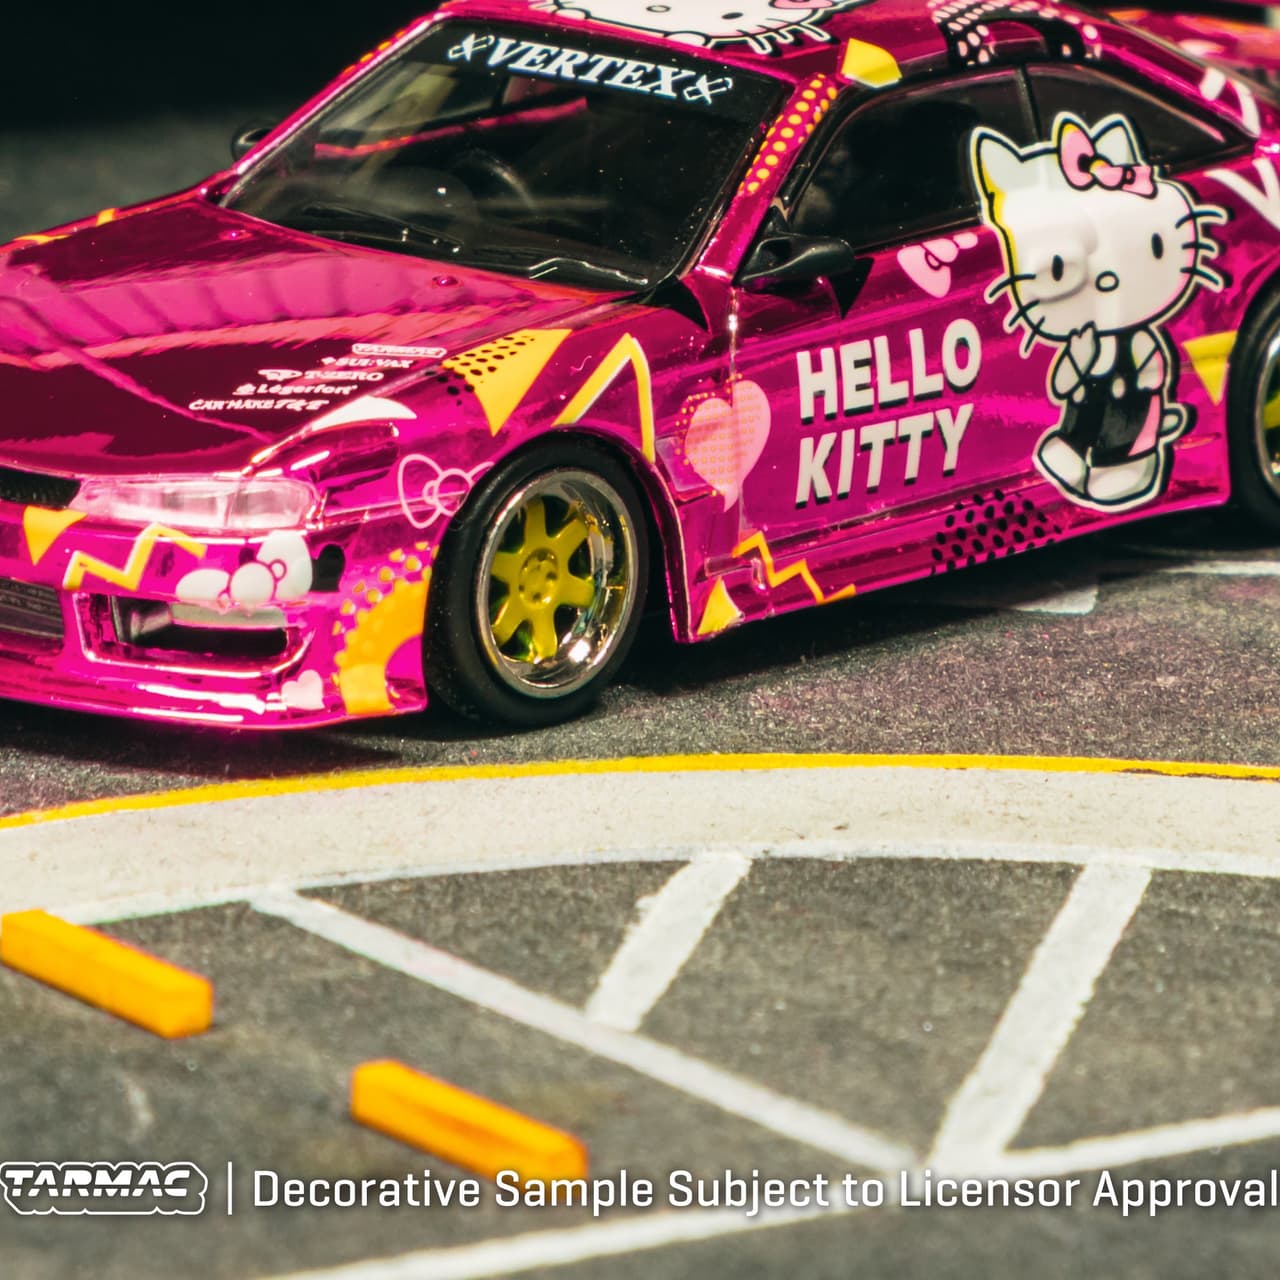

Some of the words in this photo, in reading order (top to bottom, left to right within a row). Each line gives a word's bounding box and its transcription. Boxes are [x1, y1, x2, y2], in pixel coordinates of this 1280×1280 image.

[486, 37, 698, 101] VERTEX
[796, 319, 982, 424] HELLO
[795, 403, 974, 509] KITTY
